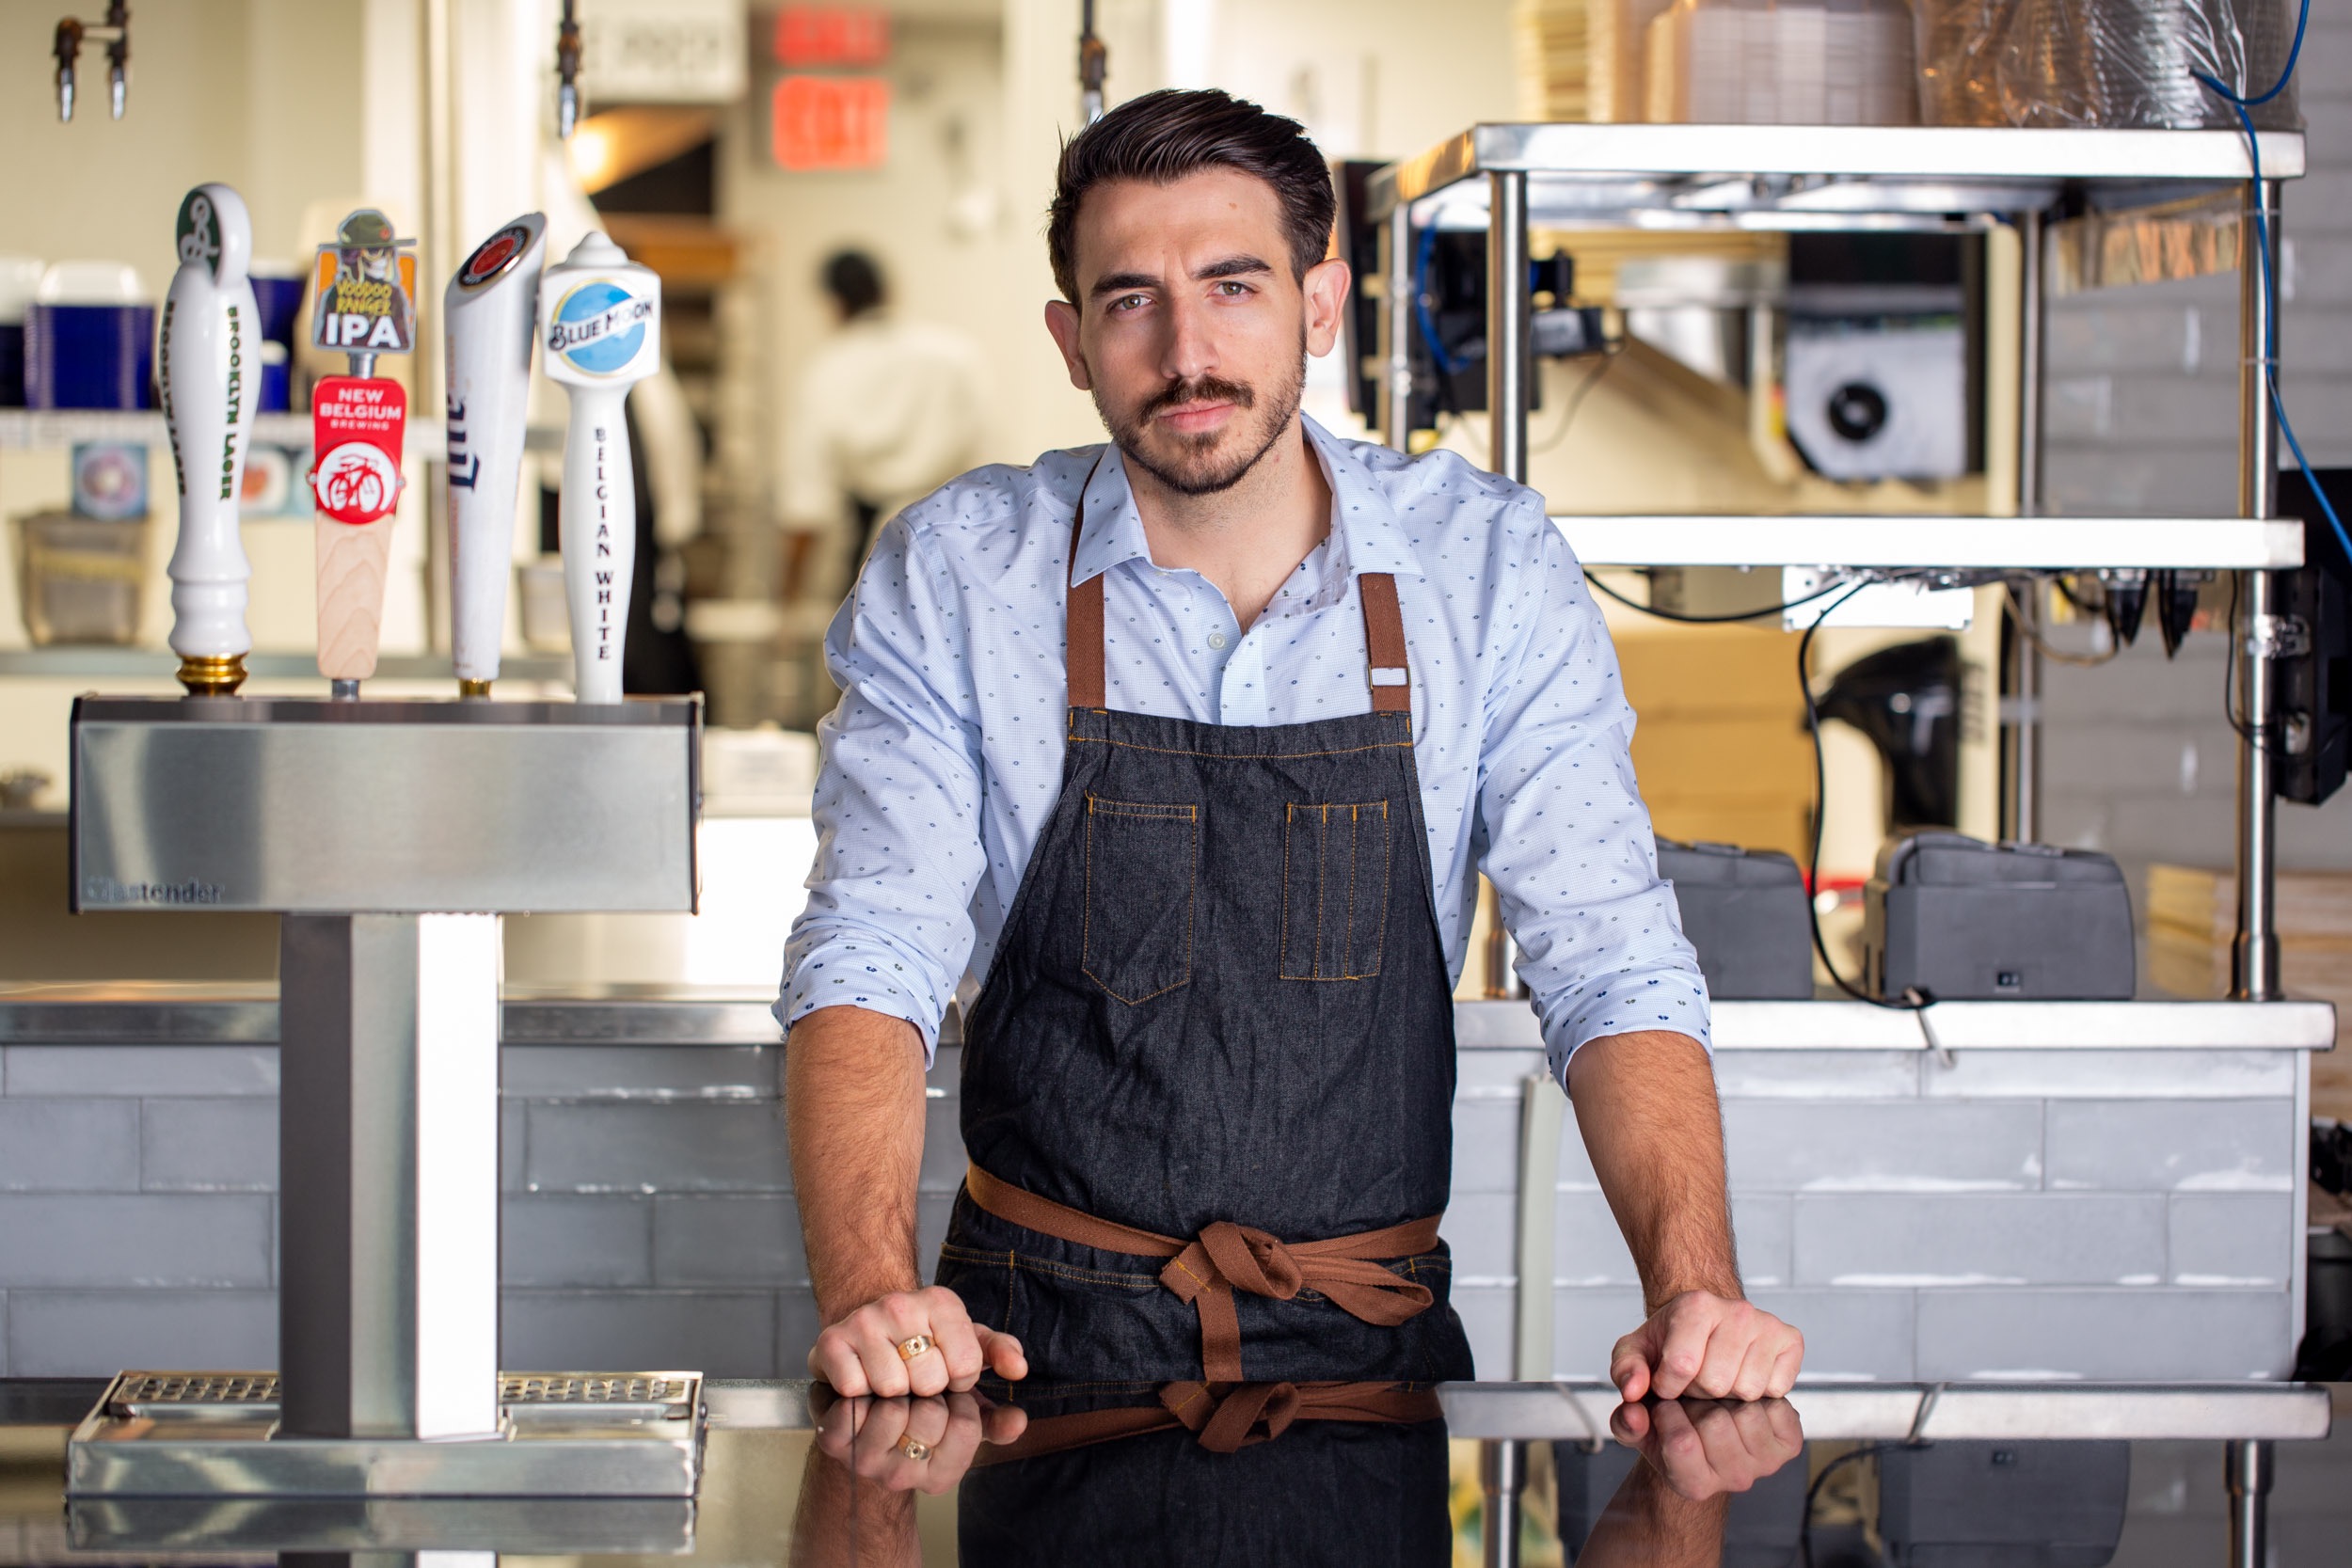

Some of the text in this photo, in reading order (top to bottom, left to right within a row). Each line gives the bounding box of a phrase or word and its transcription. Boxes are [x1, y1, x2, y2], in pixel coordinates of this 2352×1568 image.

[336, 279, 393, 298] VOODOO
[336, 297, 392, 315] RANGER
[326, 313, 402, 347] IPA
[548, 321, 599, 351] BLUE
[220, 306, 241, 500] BROOKLYN LAGER
[338, 388, 384, 404] NEW
[319, 403, 402, 420] BELGIUM
[330, 420, 390, 432] BREWING
[595, 429, 612, 659] BELGIAN WHITE
